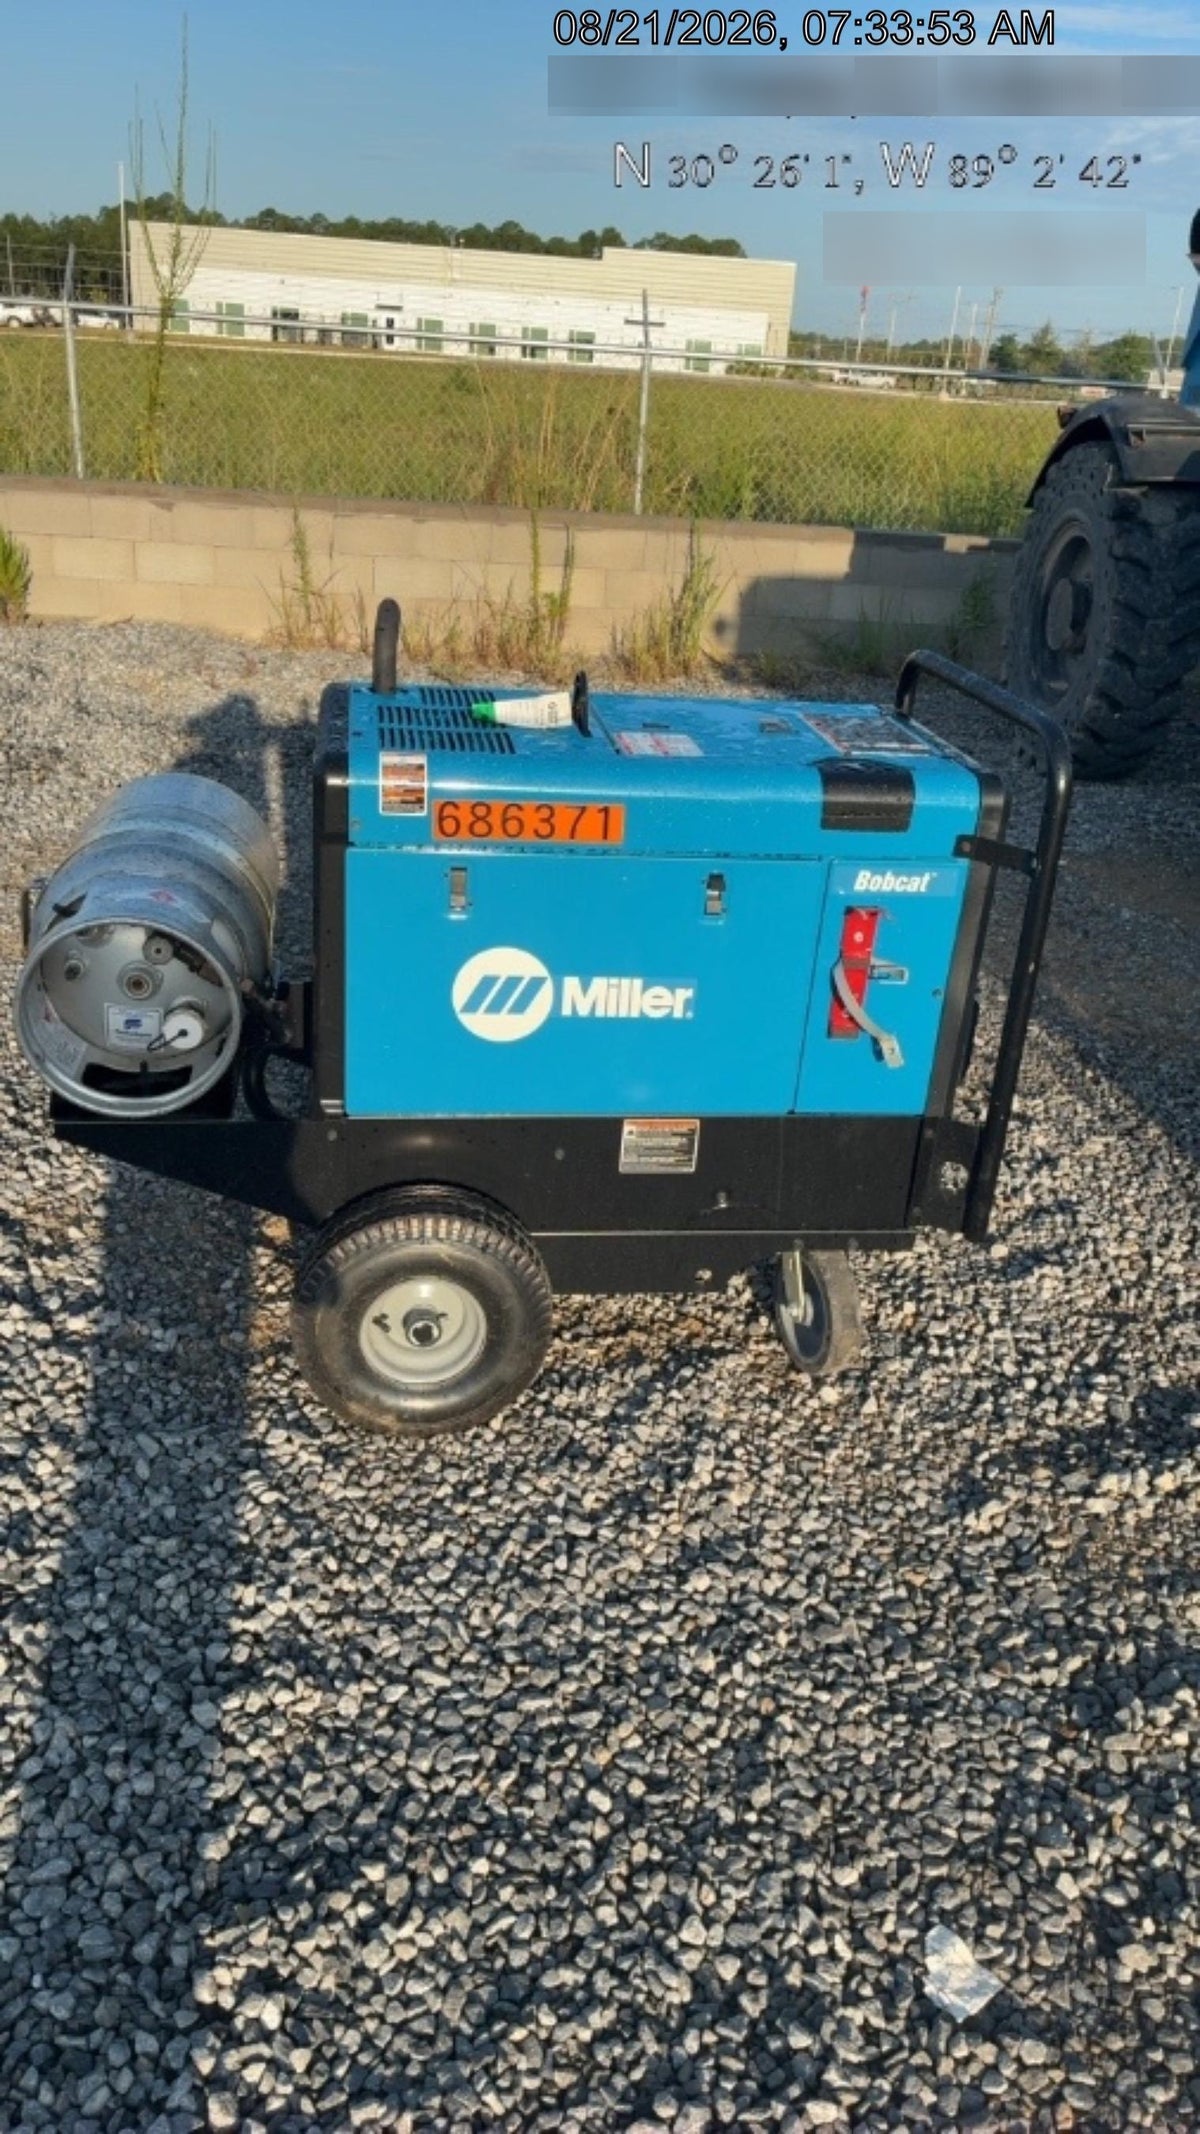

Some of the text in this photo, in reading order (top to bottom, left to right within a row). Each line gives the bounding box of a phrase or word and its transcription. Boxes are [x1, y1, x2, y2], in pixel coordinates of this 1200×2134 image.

[438, 801, 611, 840] 686371
[853, 869, 931, 893] Bobcat
[562, 976, 693, 1018] Miller
